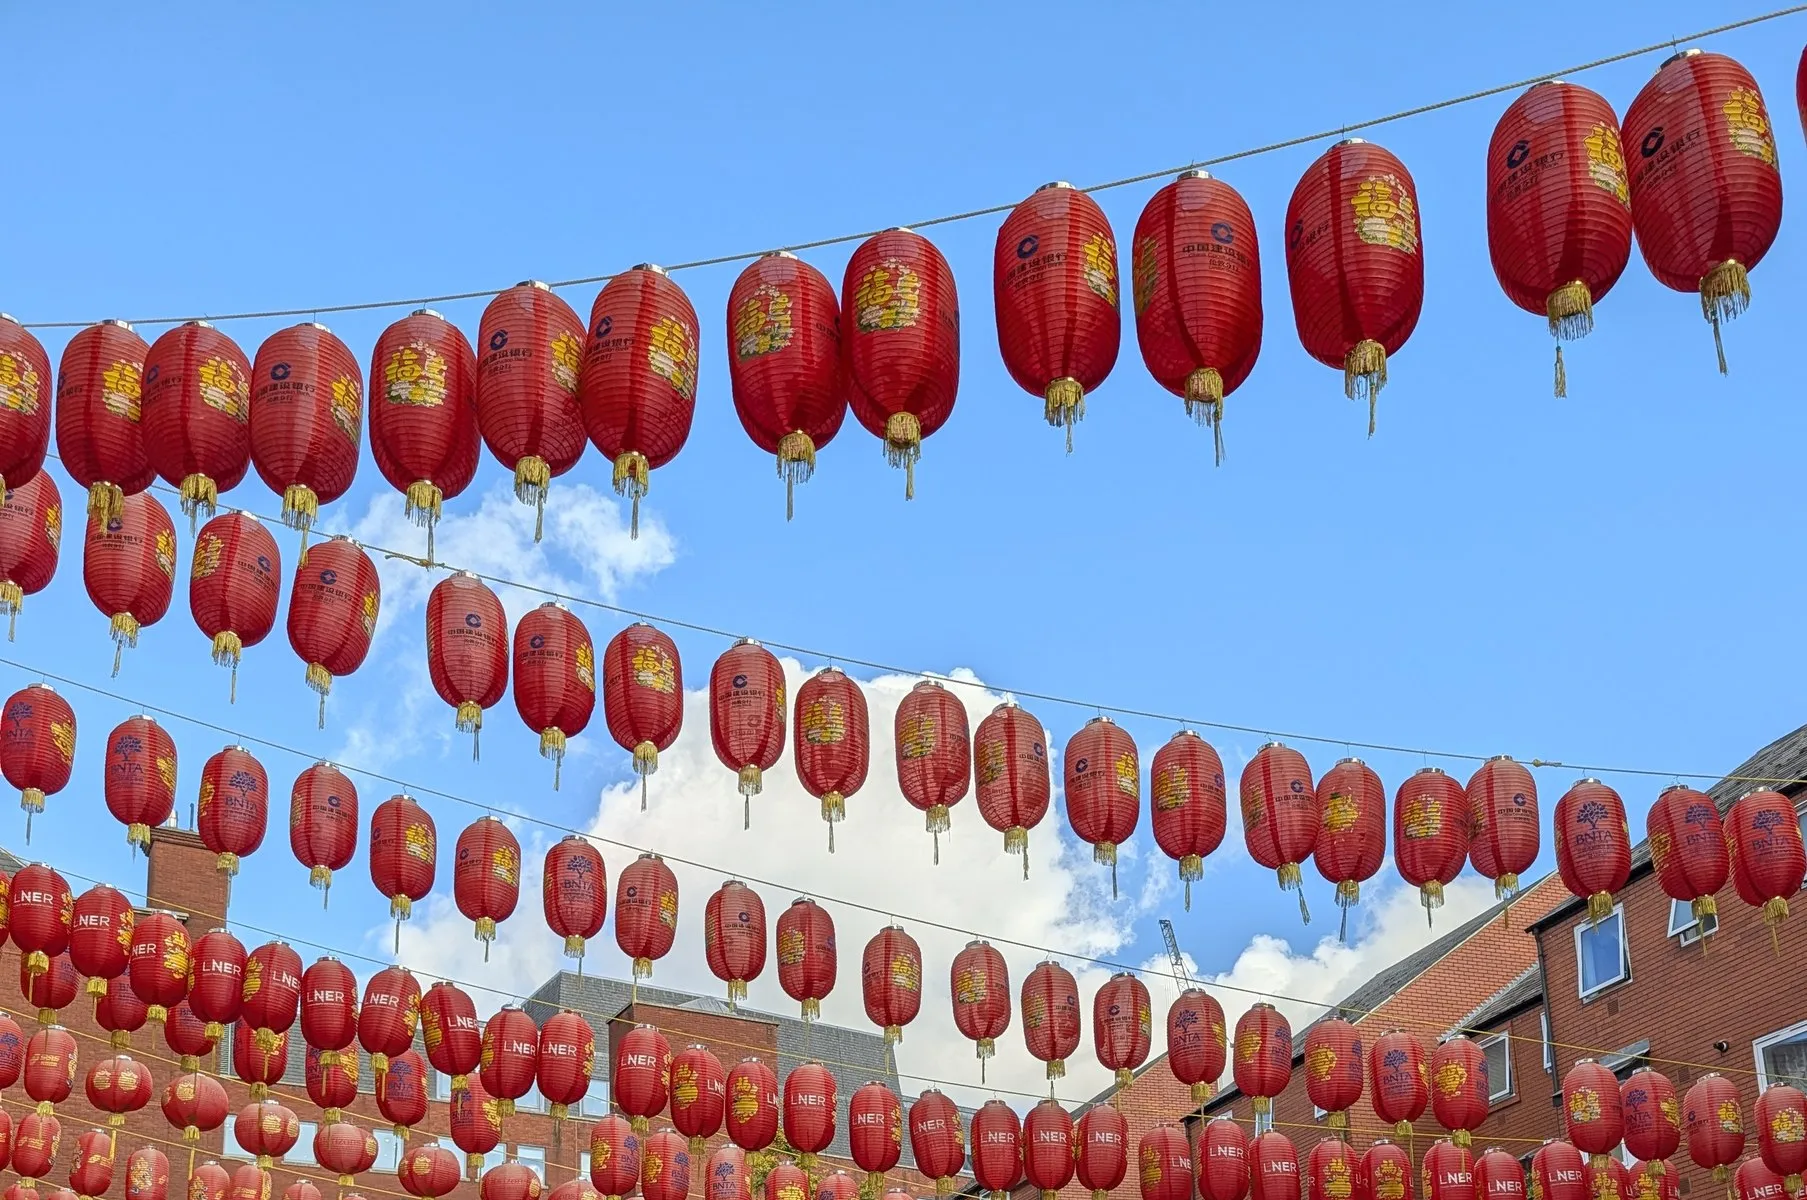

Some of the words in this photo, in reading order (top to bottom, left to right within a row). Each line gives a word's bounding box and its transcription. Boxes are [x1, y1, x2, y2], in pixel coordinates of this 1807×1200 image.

[1576, 831, 1613, 845] BNTA
[14, 890, 53, 904] LNER
[74, 915, 110, 928] LNER
[132, 943, 156, 955] NER
[202, 958, 241, 974] LNER
[273, 970, 300, 988] LNE
[307, 989, 345, 1003] LNER
[364, 991, 399, 1007] LNER
[1174, 1033, 1201, 1045] BNTA
[504, 1039, 536, 1055] LNER
[542, 1041, 577, 1056] LNER
[621, 1054, 656, 1067] LNER
[1384, 1072, 1412, 1085] BNTA
[707, 1079, 724, 1093] LNE
[792, 1094, 825, 1106] LNER
[853, 1113, 885, 1125] LNER
[914, 1119, 945, 1135] LNER
[981, 1131, 1015, 1143] LNER
[1033, 1131, 1067, 1143] LNER
[1088, 1131, 1121, 1144] LNER
[1210, 1145, 1243, 1157] LNER
[1172, 1156, 1191, 1169] LNE
[1264, 1161, 1296, 1173] LNER
[1439, 1170, 1472, 1185] LNER
[1549, 1170, 1583, 1183] LNER
[713, 1183, 736, 1191] BNTA
[1488, 1180, 1522, 1194] LNER
[1747, 1184, 1783, 1200] LNER
